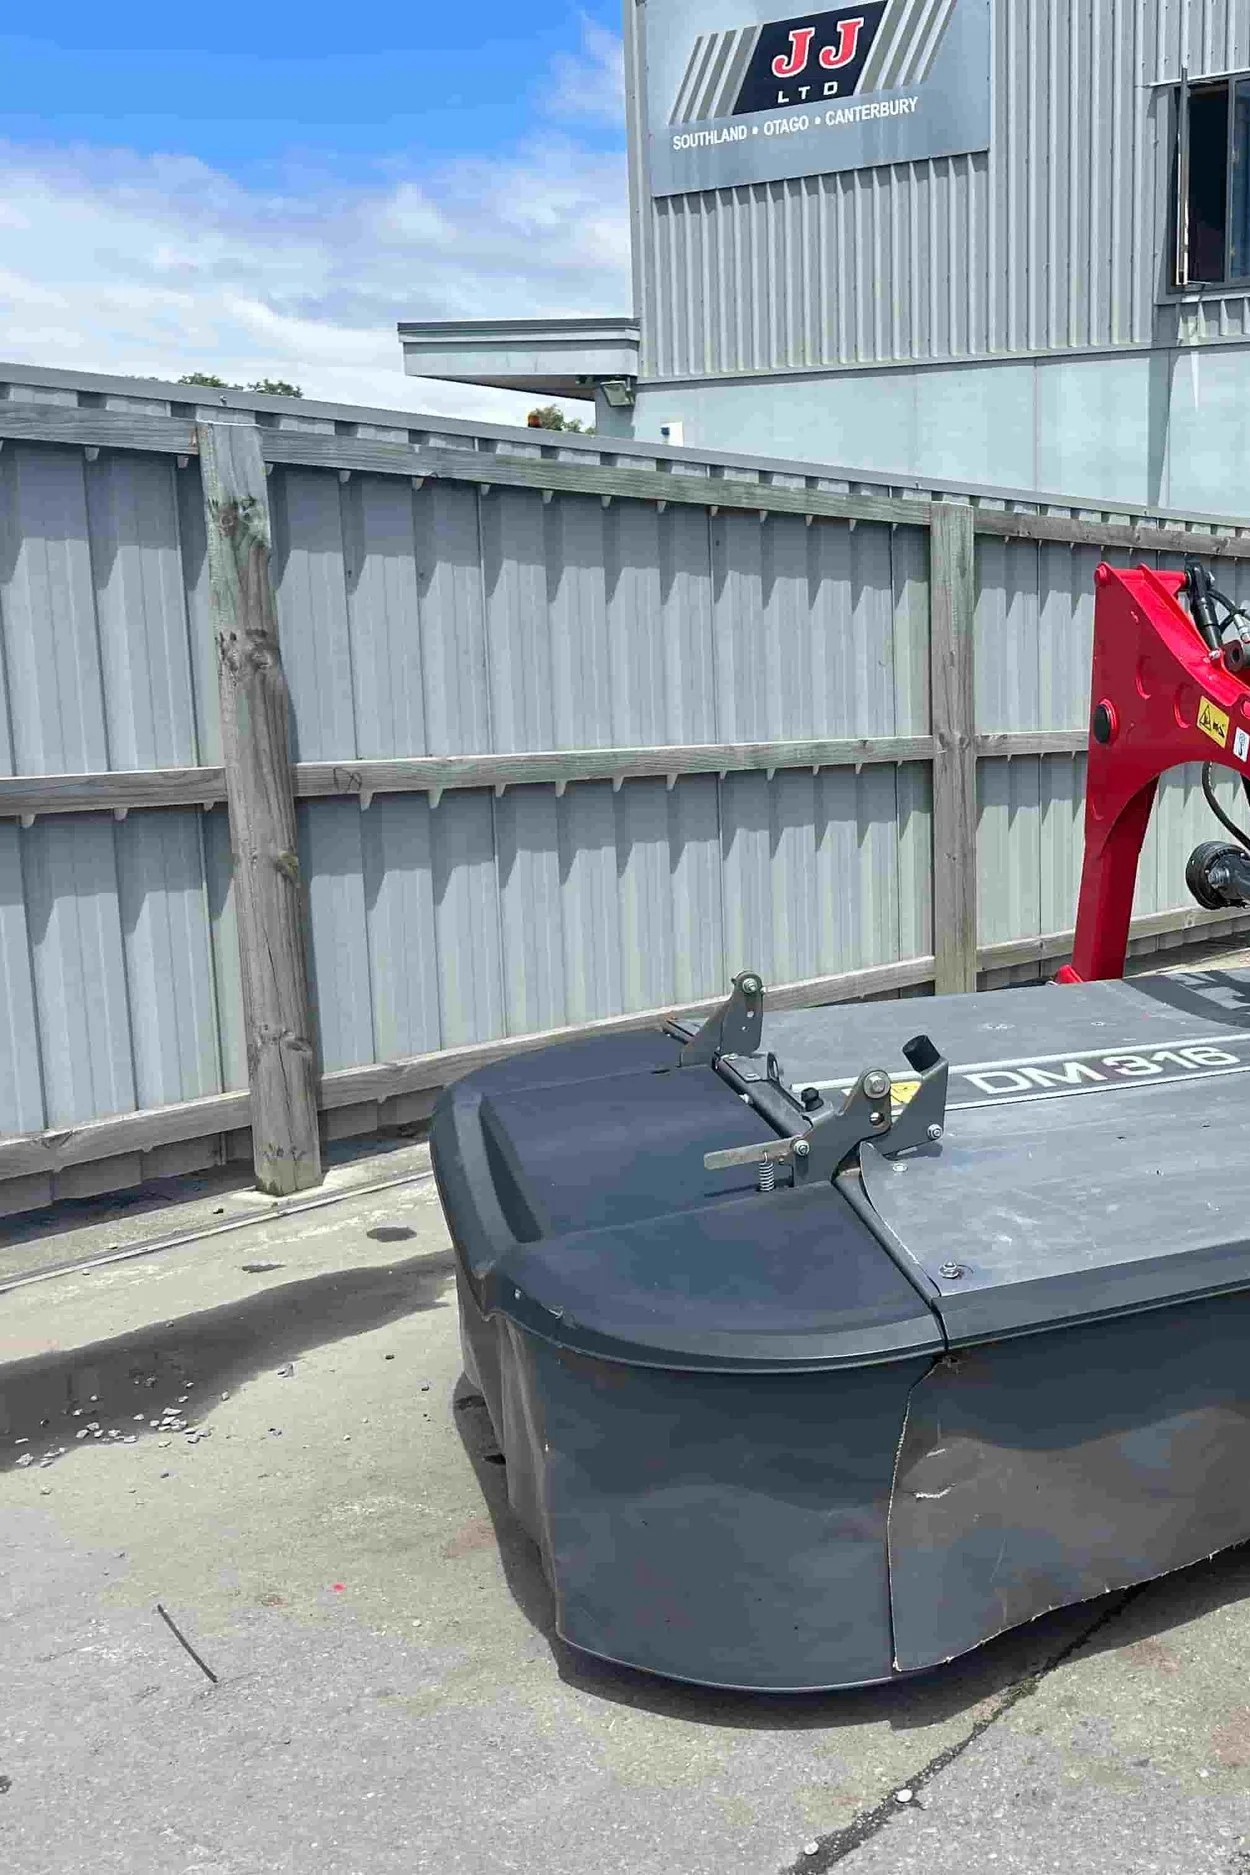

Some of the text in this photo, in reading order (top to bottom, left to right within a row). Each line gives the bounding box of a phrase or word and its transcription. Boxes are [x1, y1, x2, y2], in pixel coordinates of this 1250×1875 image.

[772, 17, 864, 78] JJ
[777, 81, 838, 104] LTD
[672, 96, 919, 151] SOUTHLAND OTAGO CANTERBURY
[962, 1061, 1107, 1095] DM
[1102, 1046, 1241, 1077] 316
